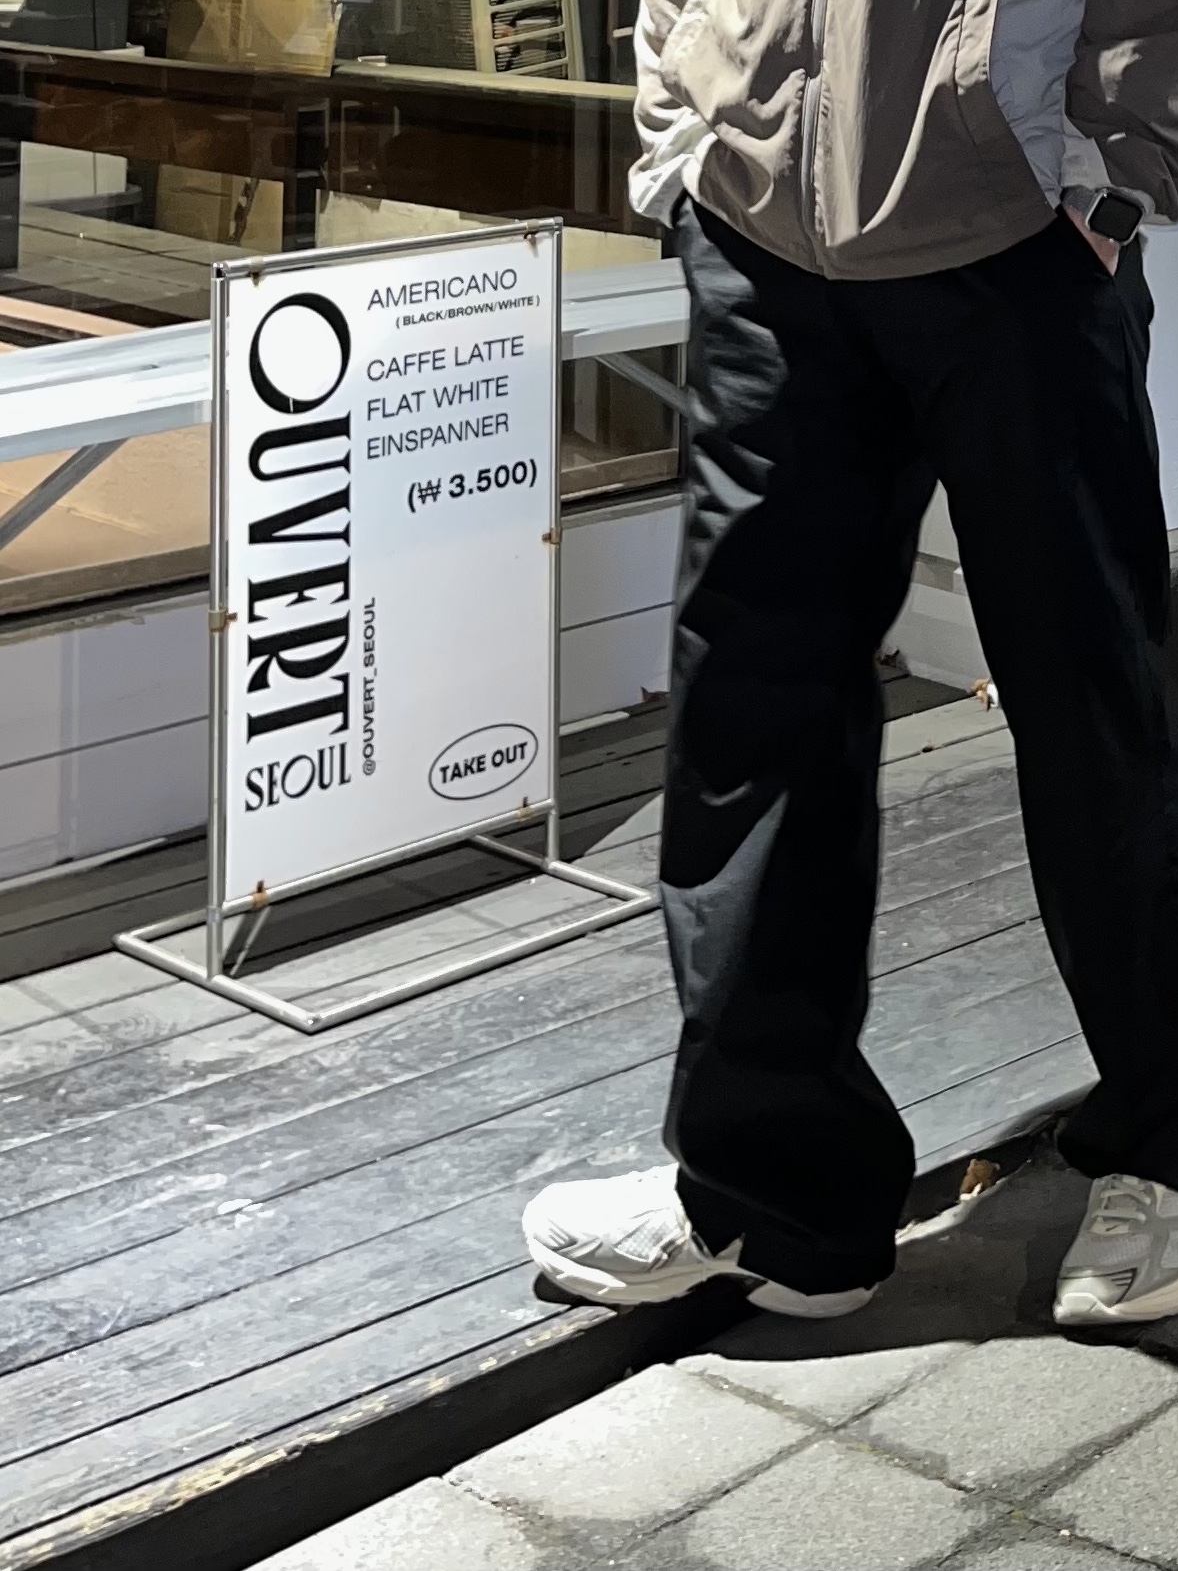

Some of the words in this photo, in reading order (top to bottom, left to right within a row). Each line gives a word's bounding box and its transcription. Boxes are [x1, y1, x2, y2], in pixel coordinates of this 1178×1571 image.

[367, 268, 518, 311] AMERICANO
[366, 348, 446, 382] CAFFE
[454, 335, 525, 367] LATTE
[366, 390, 427, 421] FLAT
[432, 375, 510, 409] WHITE
[366, 413, 510, 460] EINSPANNER
[247, 291, 352, 745] OUVERT
[362, 596, 378, 776] @OUVERT_SEOUL
[244, 741, 352, 813] SEOUL
[439, 749, 487, 784] TAKE
[490, 741, 528, 768] OUT
